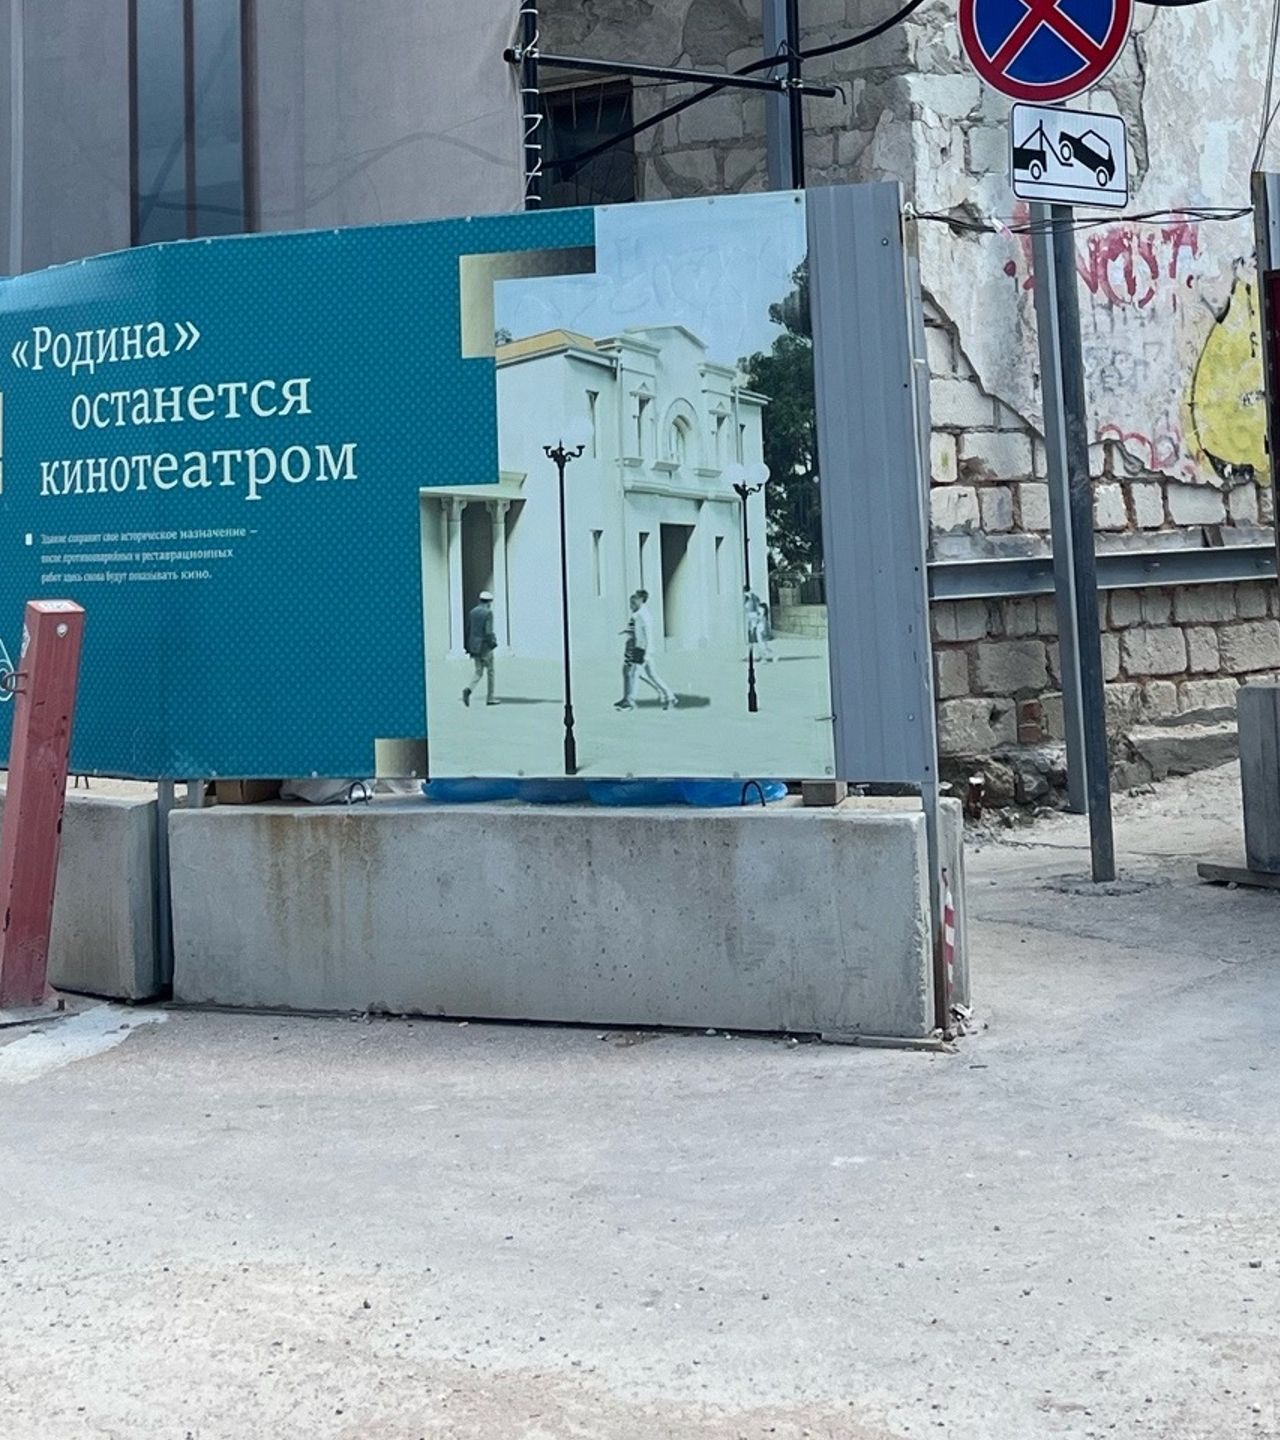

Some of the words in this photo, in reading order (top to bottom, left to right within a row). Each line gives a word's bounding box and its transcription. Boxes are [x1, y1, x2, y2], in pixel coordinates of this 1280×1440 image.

[11, 320, 201, 376] «Родина»
[71, 377, 312, 430] останется
[39, 442, 359, 500] кинотеатром
[180, 528, 246, 539] назначение
[141, 549, 233, 563] реставрационных
[180, 569, 212, 580] кино.
